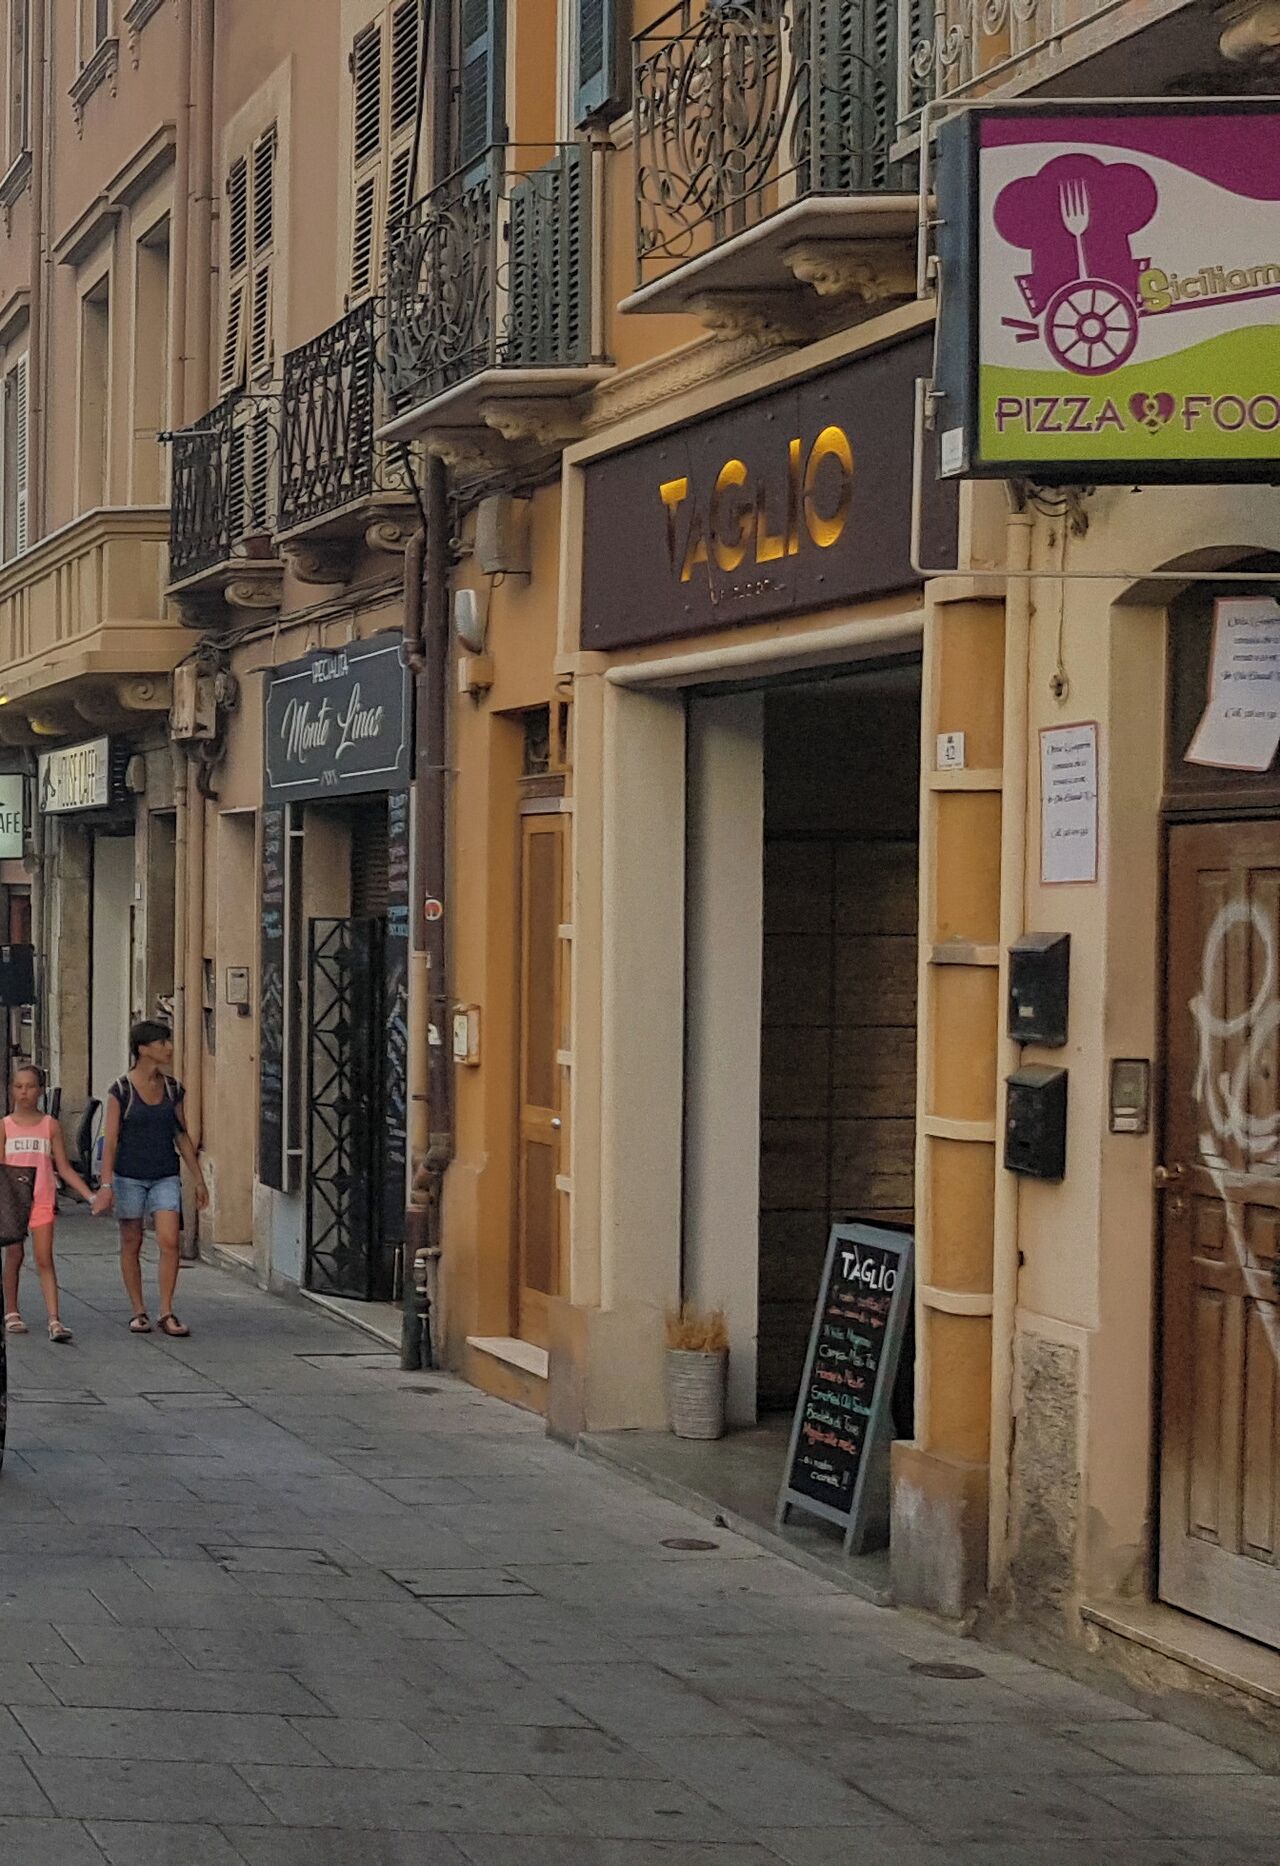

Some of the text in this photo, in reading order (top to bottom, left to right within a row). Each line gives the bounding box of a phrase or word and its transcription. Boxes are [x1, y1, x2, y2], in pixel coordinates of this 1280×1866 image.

[995, 396, 1126, 433] PIZZA
[659, 425, 854, 604] TAGLIO
[280, 682, 383, 764] Monte Linas
[841, 1248, 897, 1292] TAGLIO
